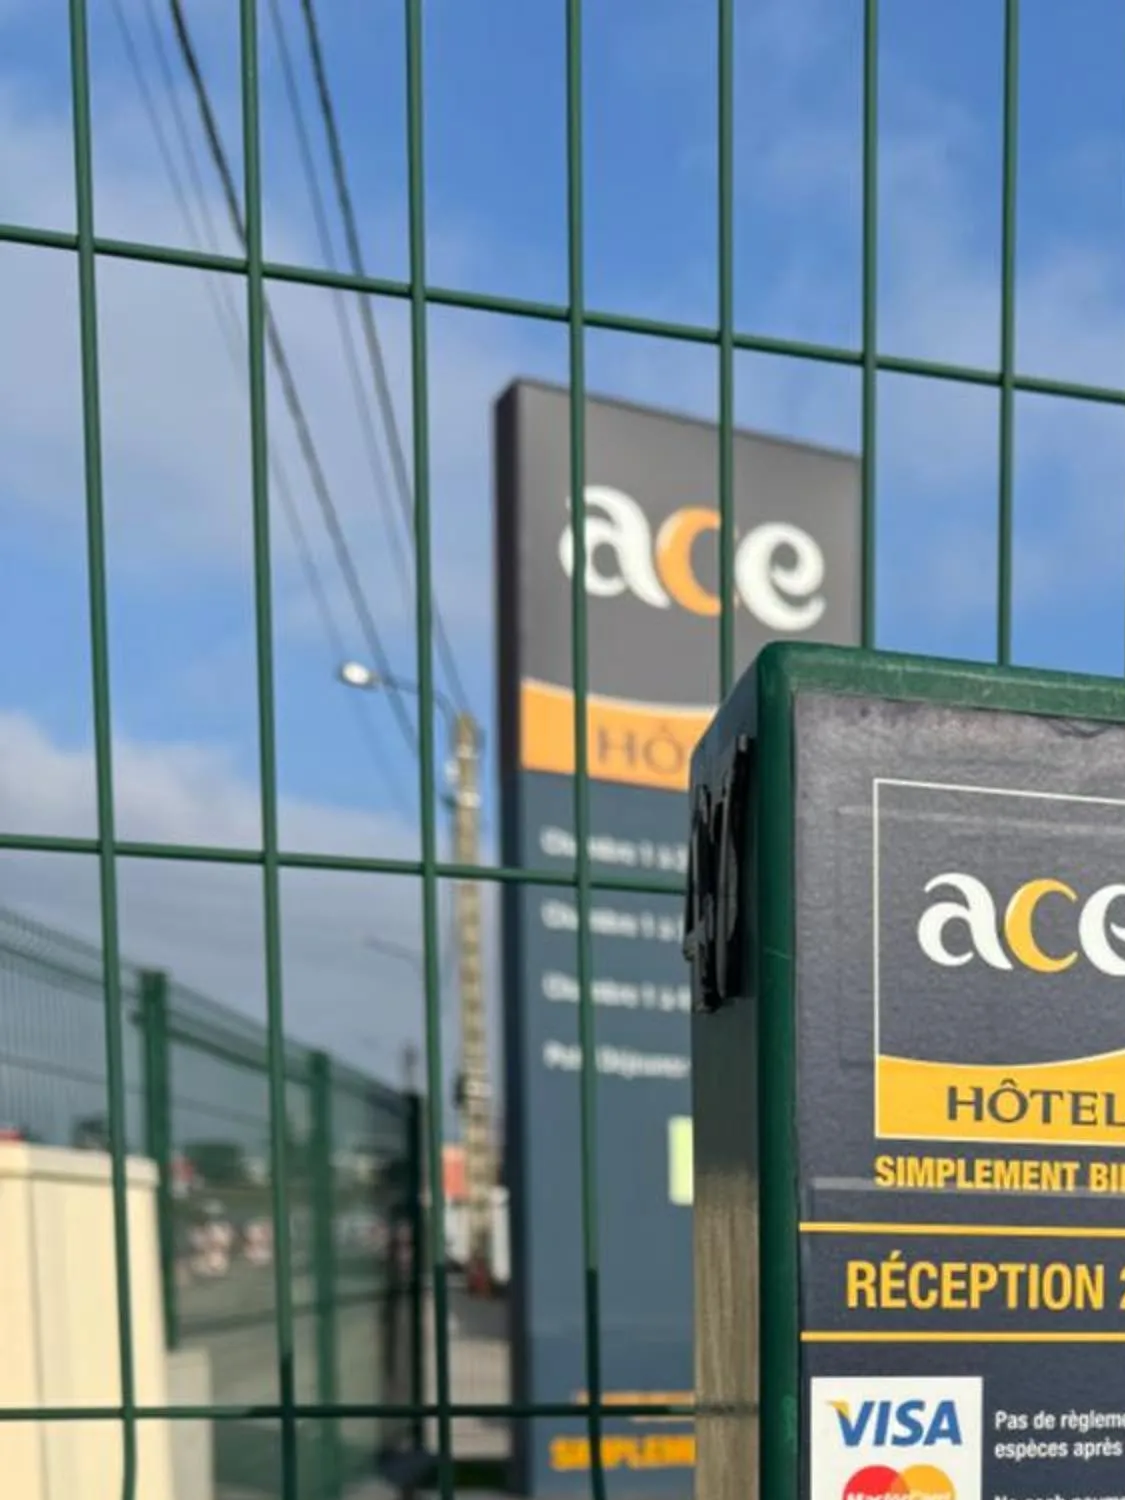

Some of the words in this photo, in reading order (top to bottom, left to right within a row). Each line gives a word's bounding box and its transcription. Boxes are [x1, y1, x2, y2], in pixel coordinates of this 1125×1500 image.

[559, 485, 826, 631] ace
[874, 1155, 1080, 1192] SIMPLEMENT
[846, 1249, 1105, 1311] RÉCEPTION
[826, 1399, 963, 1447] VISA
[994, 1409, 1028, 1430] Pas
[1033, 1410, 1056, 1430] de
[994, 1438, 1068, 1461] espèces
[1073, 1437, 1123, 1460] après
